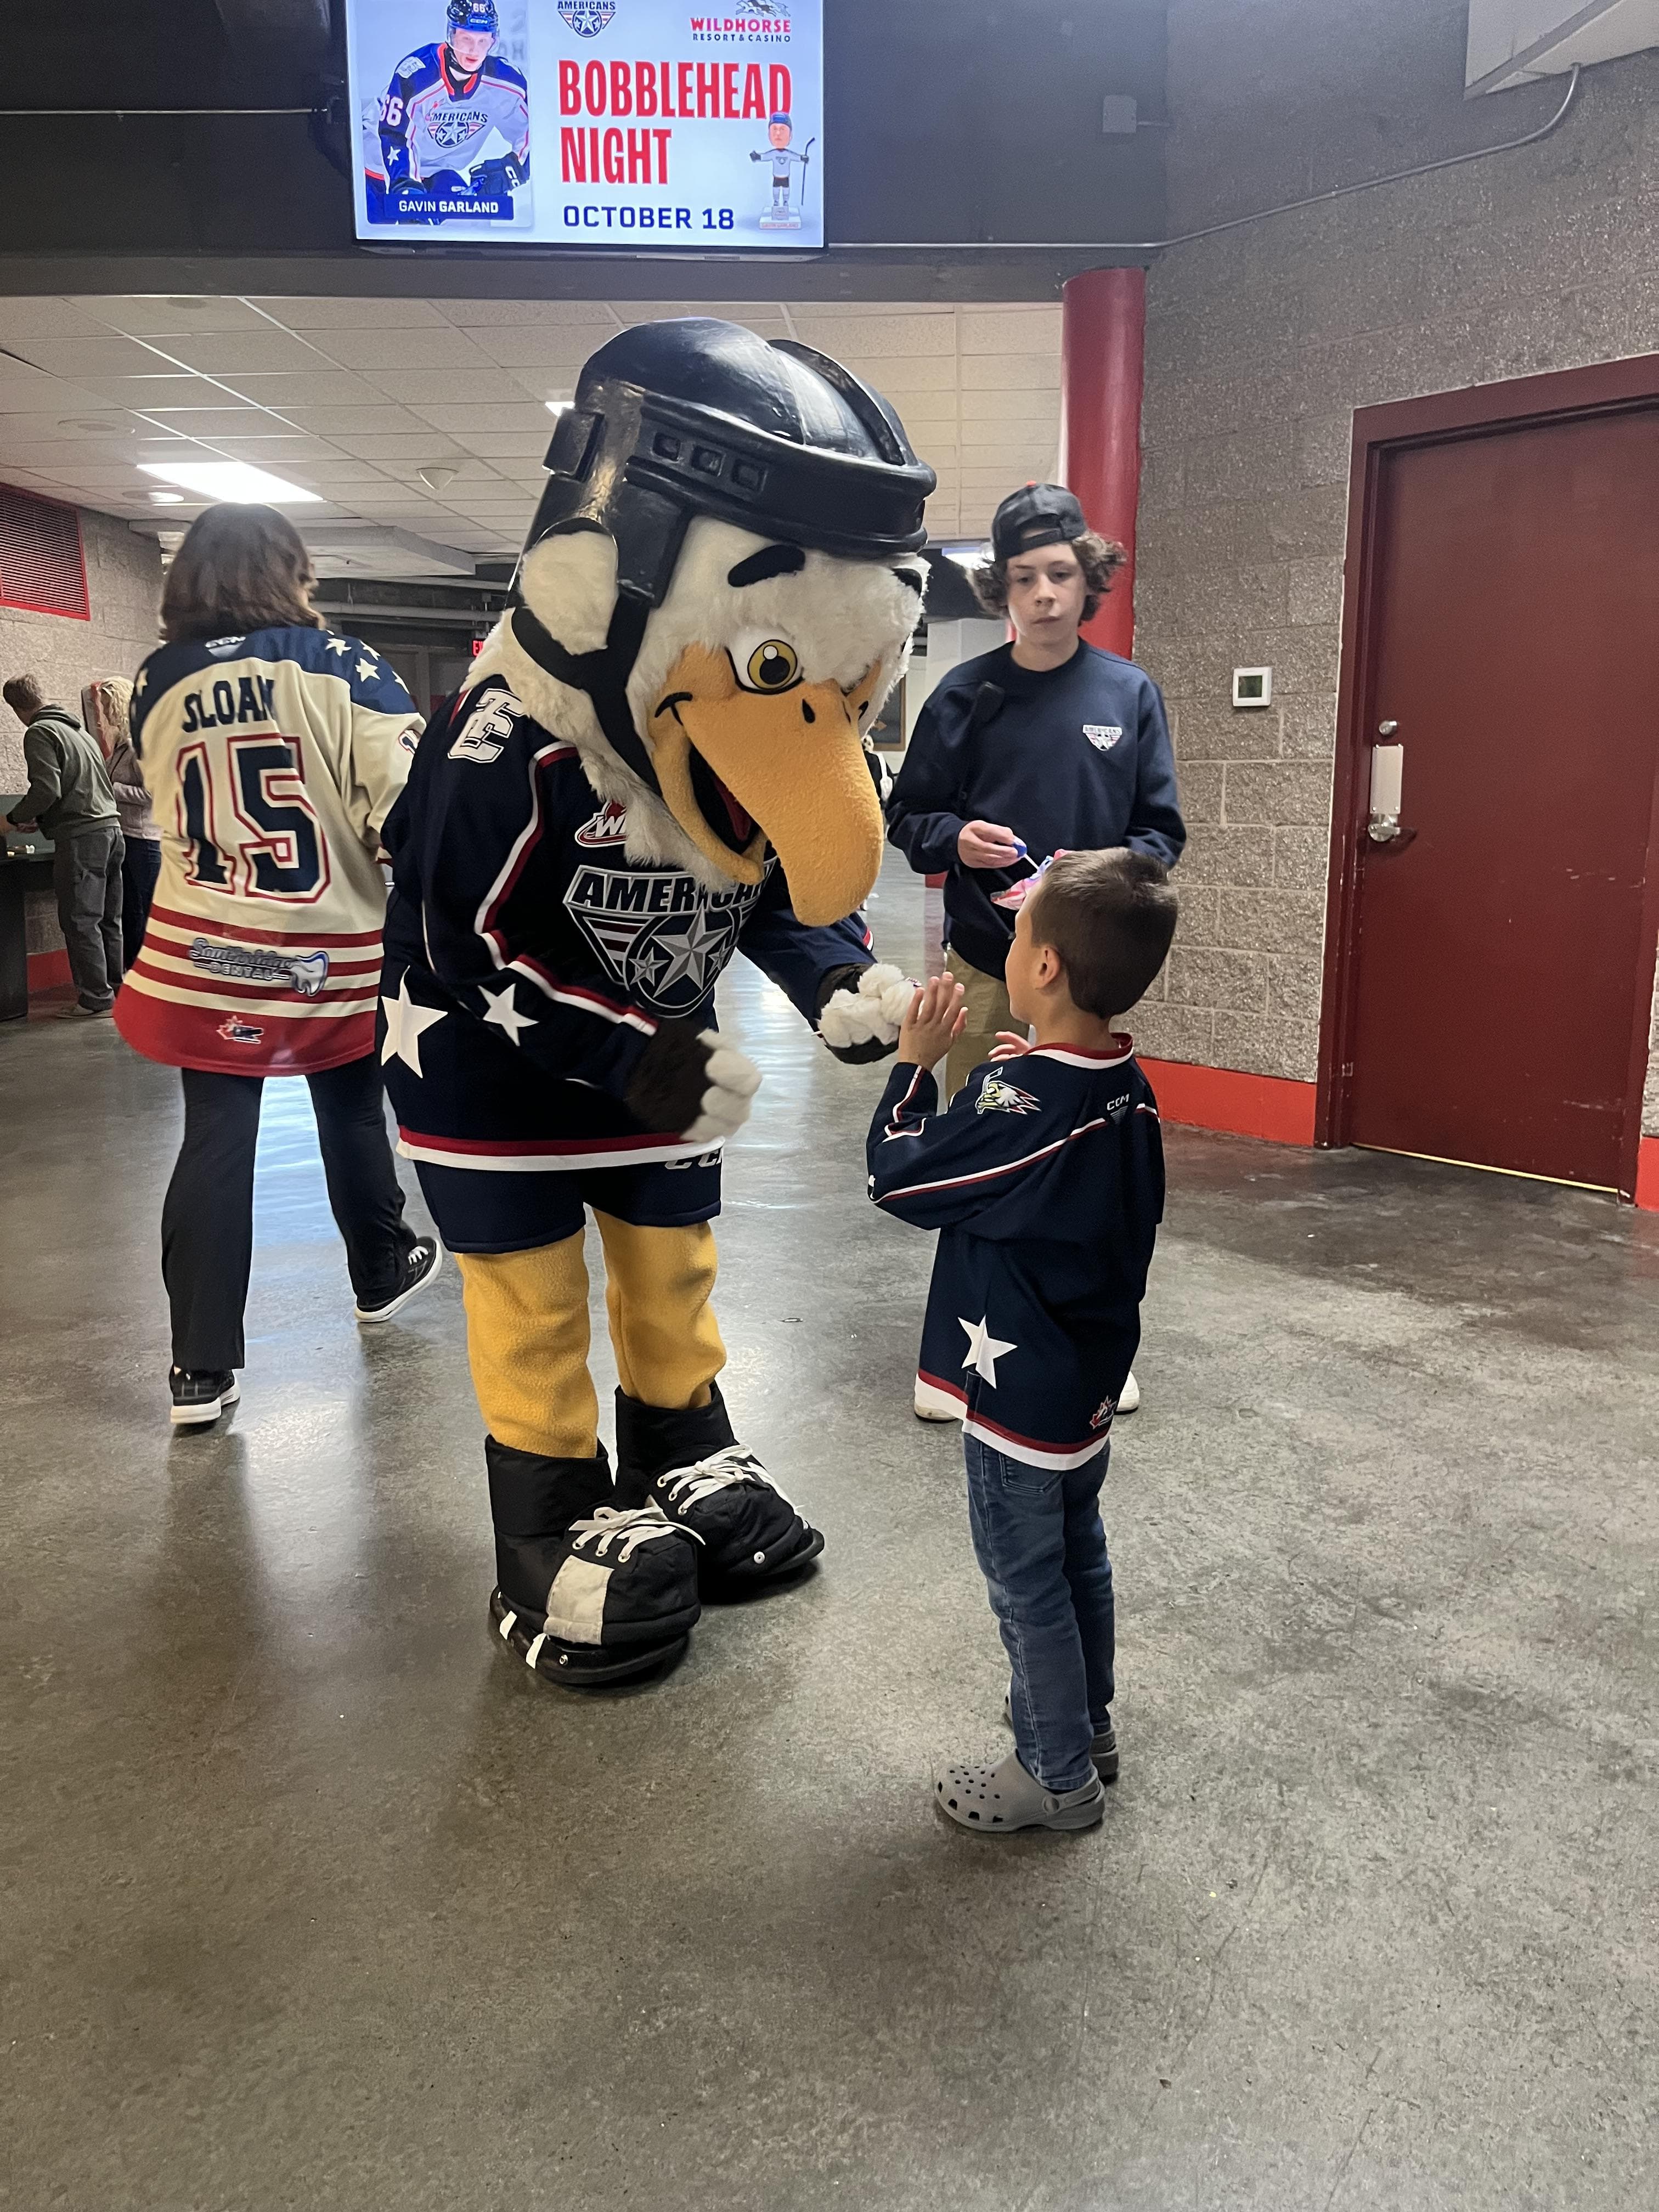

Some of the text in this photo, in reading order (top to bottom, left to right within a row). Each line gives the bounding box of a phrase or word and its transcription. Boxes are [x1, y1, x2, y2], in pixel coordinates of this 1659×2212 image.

[557, 1, 616, 10] AMERICANS
[690, 18, 791, 33] WILDHORSE
[558, 60, 792, 120] BOBBLEHEAD
[430, 111, 488, 123] MERICANS
[560, 127, 672, 185] NIGHT
[399, 200, 499, 213] GAVIN GARLAND
[563, 206, 735, 230] OCTOBER 18
[176, 732, 331, 904] 15
[209, 962, 274, 981] DENTAL
[1107, 1093, 1130, 1110] CCM
